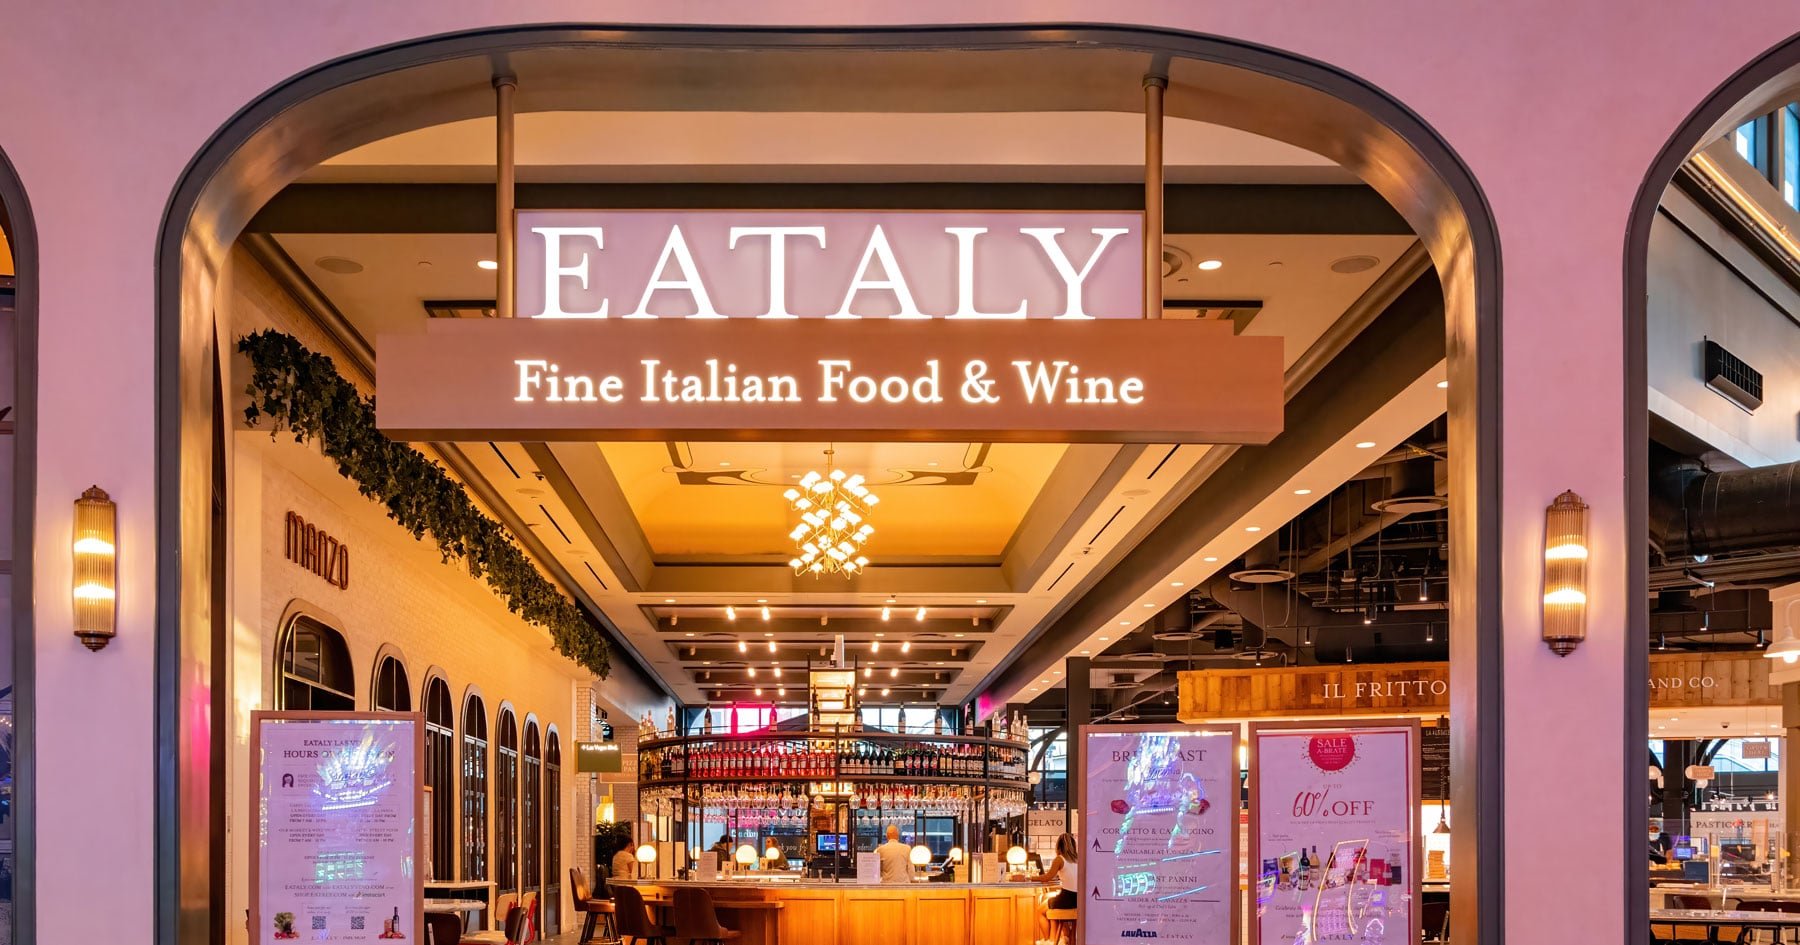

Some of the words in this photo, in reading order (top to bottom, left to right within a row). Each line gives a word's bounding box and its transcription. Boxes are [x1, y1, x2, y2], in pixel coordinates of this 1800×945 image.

[531, 224, 1129, 318] EATALY
[513, 359, 624, 402] Fine
[640, 358, 801, 402] Italian
[817, 359, 943, 403] Food
[960, 359, 1000, 403] &
[1011, 361, 1144, 404] Wine
[1323, 683, 1346, 698] IL
[1355, 680, 1447, 698] FRITTO
[1648, 677, 1682, 689] AND
[1689, 676, 1719, 688] CO.
[1316, 738, 1347, 748] SALE
[283, 750, 319, 758] HOURS
[1112, 749, 1207, 762] BRAST
[1292, 787, 1329, 817] 60%
[1332, 800, 1375, 816] OFF
[1028, 819, 1063, 827] GELATO
[1168, 875, 1197, 883] PANINI
[1121, 928, 1157, 937] LAVAZZA
